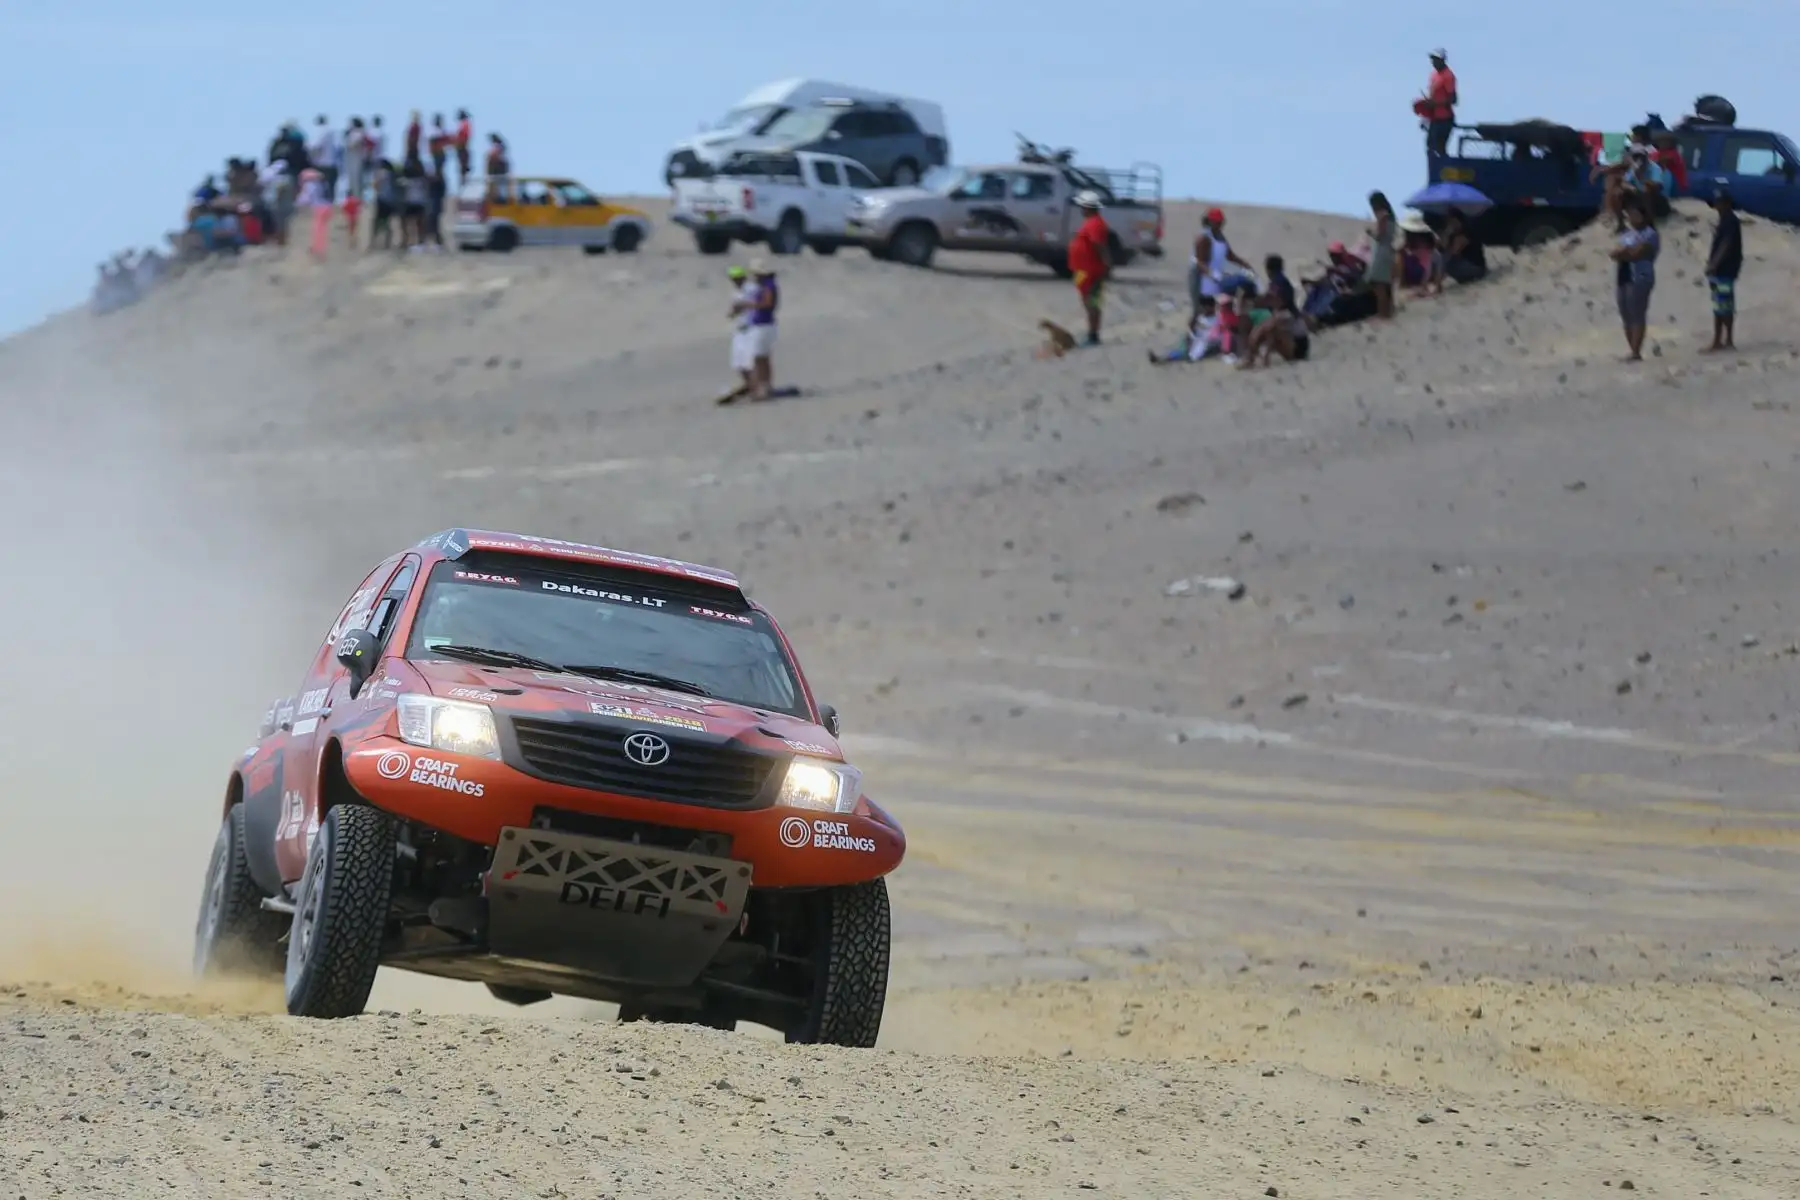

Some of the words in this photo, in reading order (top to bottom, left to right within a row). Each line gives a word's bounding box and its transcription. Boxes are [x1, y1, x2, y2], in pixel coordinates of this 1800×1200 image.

[542, 580, 667, 608] Dakaras.LT
[414, 757, 459, 776] CRAFT
[409, 769, 484, 797] BEARINGS
[813, 820, 849, 836] CRAFT
[813, 834, 876, 852] BEARINGS
[560, 881, 671, 918] DELFI
